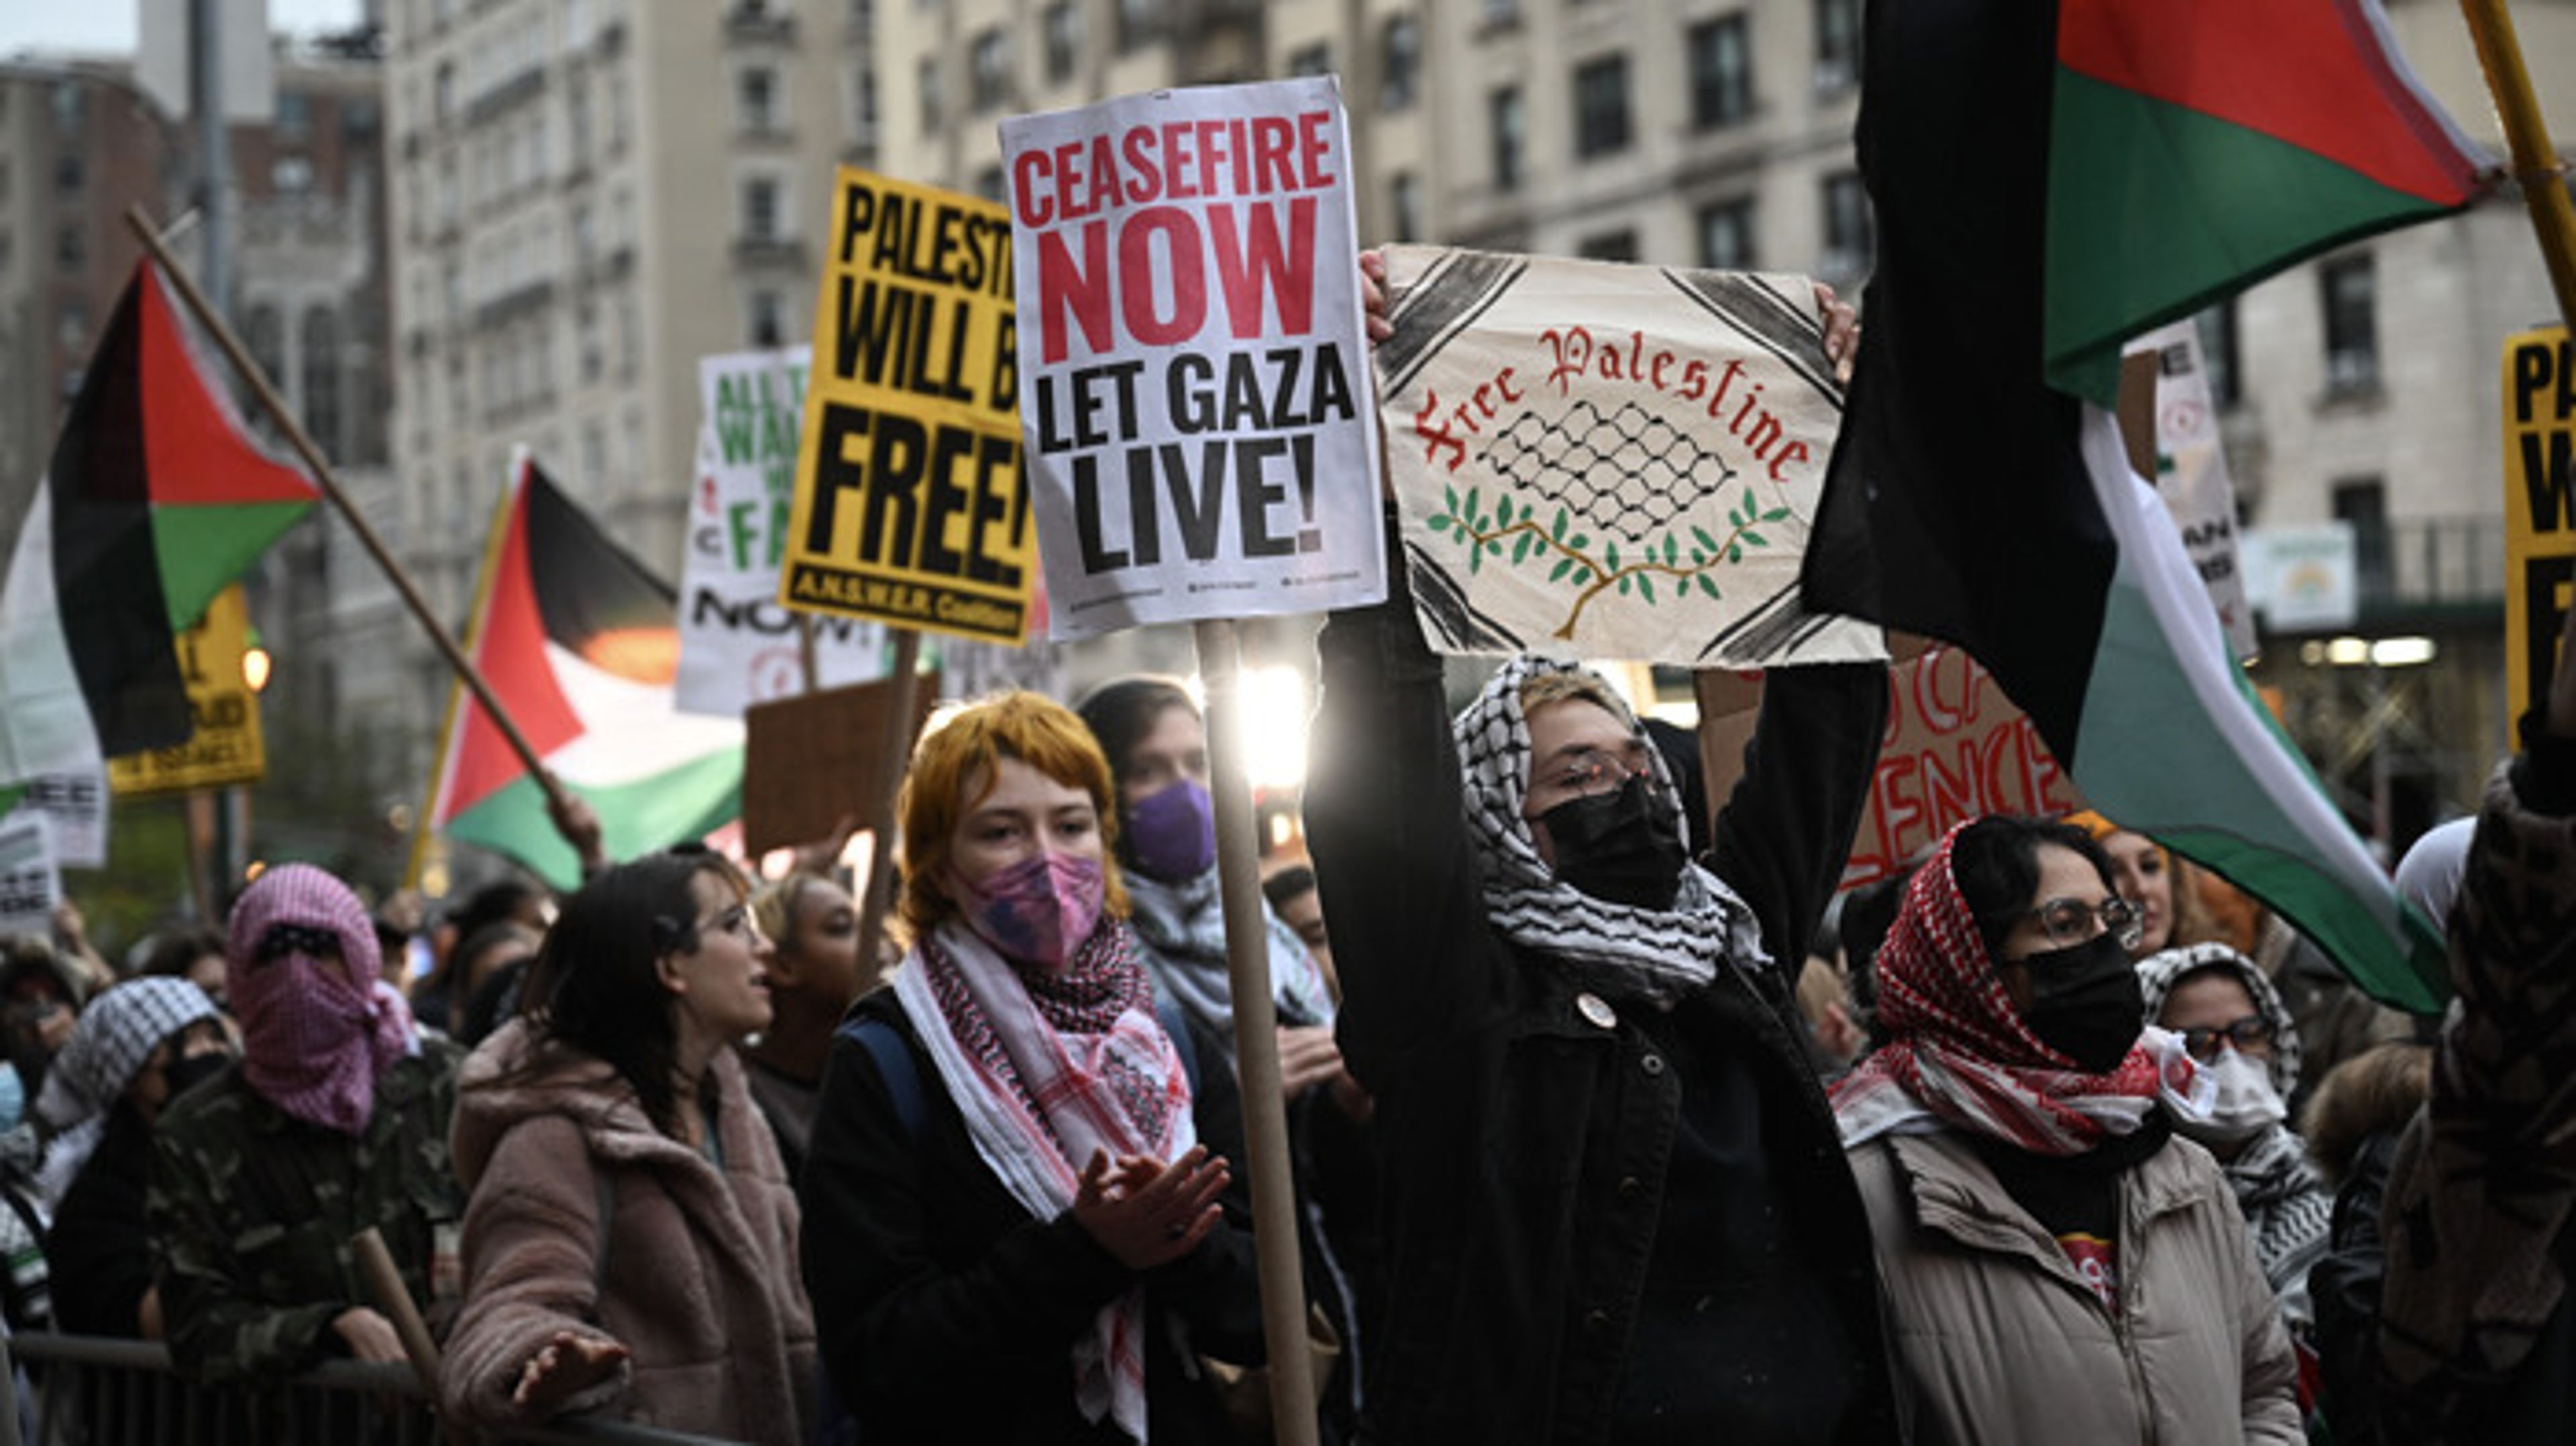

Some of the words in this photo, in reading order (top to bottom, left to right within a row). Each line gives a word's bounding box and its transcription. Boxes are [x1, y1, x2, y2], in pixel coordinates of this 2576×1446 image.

[1015, 111, 1334, 227] CEASEFIRE
[834, 274, 974, 403] WILL
[1038, 197, 1316, 363] NOW
[1036, 361, 1144, 455] LET
[1167, 342, 1355, 435] GAZA
[1415, 366, 1525, 472] Free
[1540, 325, 1810, 483] Palestine
[805, 401, 1030, 590] FREE!
[1073, 434, 1322, 576] LIVE!
